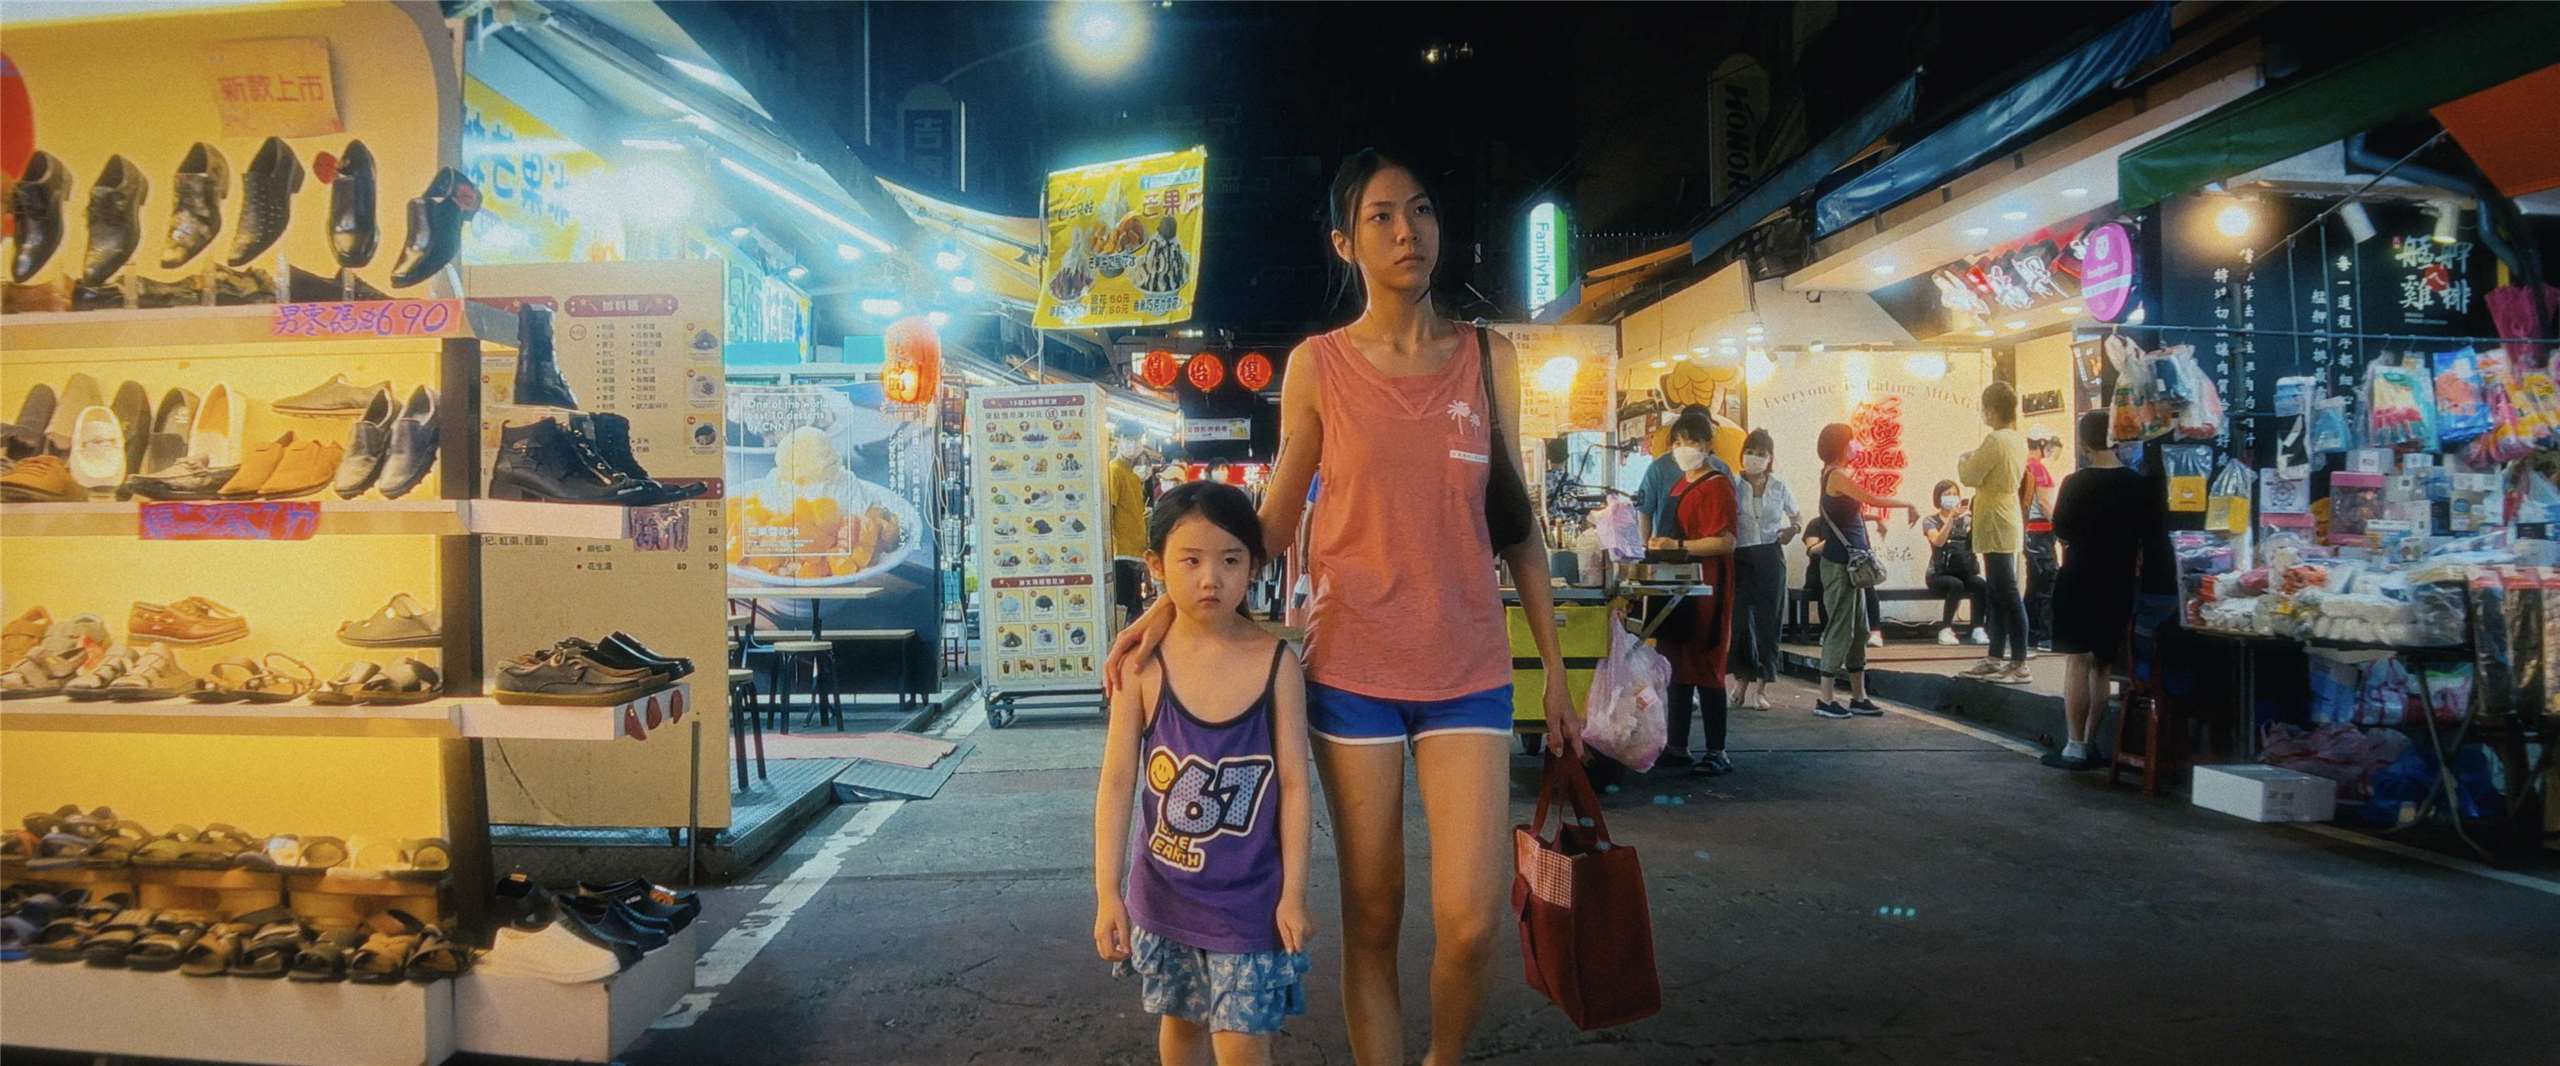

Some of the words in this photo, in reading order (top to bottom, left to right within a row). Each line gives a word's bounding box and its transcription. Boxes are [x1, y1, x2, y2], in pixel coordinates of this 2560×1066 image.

[220, 75, 324, 102] 新款上市
[1535, 222, 1550, 304] FamilyMar
[1151, 838, 1199, 867] EARTH
